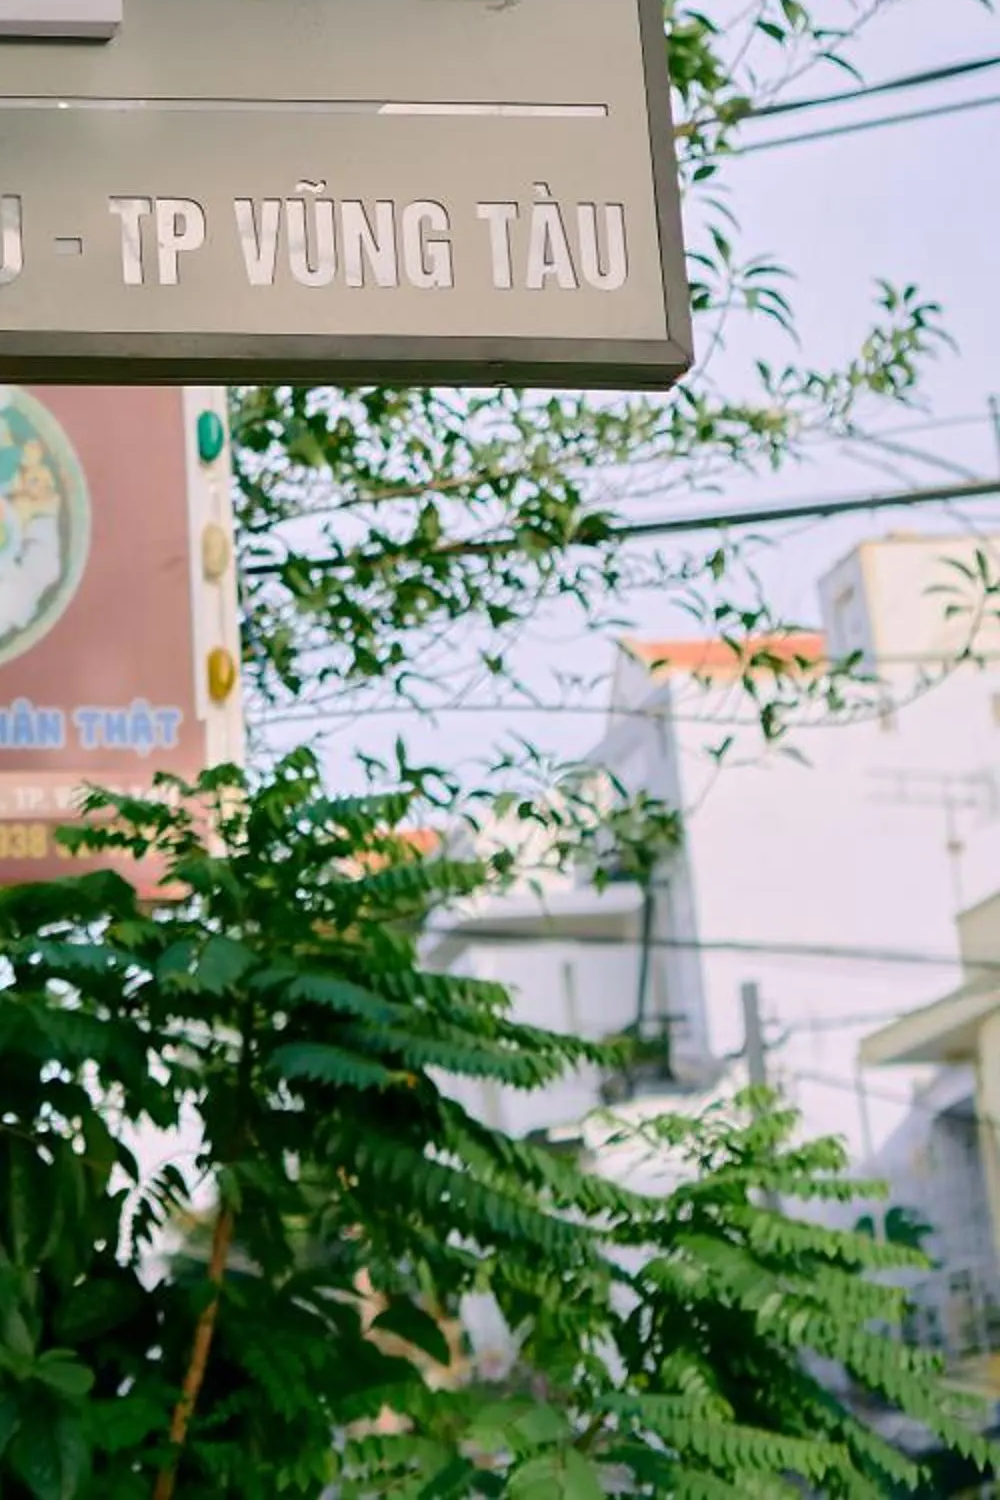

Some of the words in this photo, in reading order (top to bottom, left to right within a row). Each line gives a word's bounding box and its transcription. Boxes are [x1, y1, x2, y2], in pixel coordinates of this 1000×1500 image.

[109, 195, 207, 286] TP
[233, 178, 455, 288] VŨNG
[476, 182, 629, 291] TÀU
[73, 697, 182, 755] THẬT
